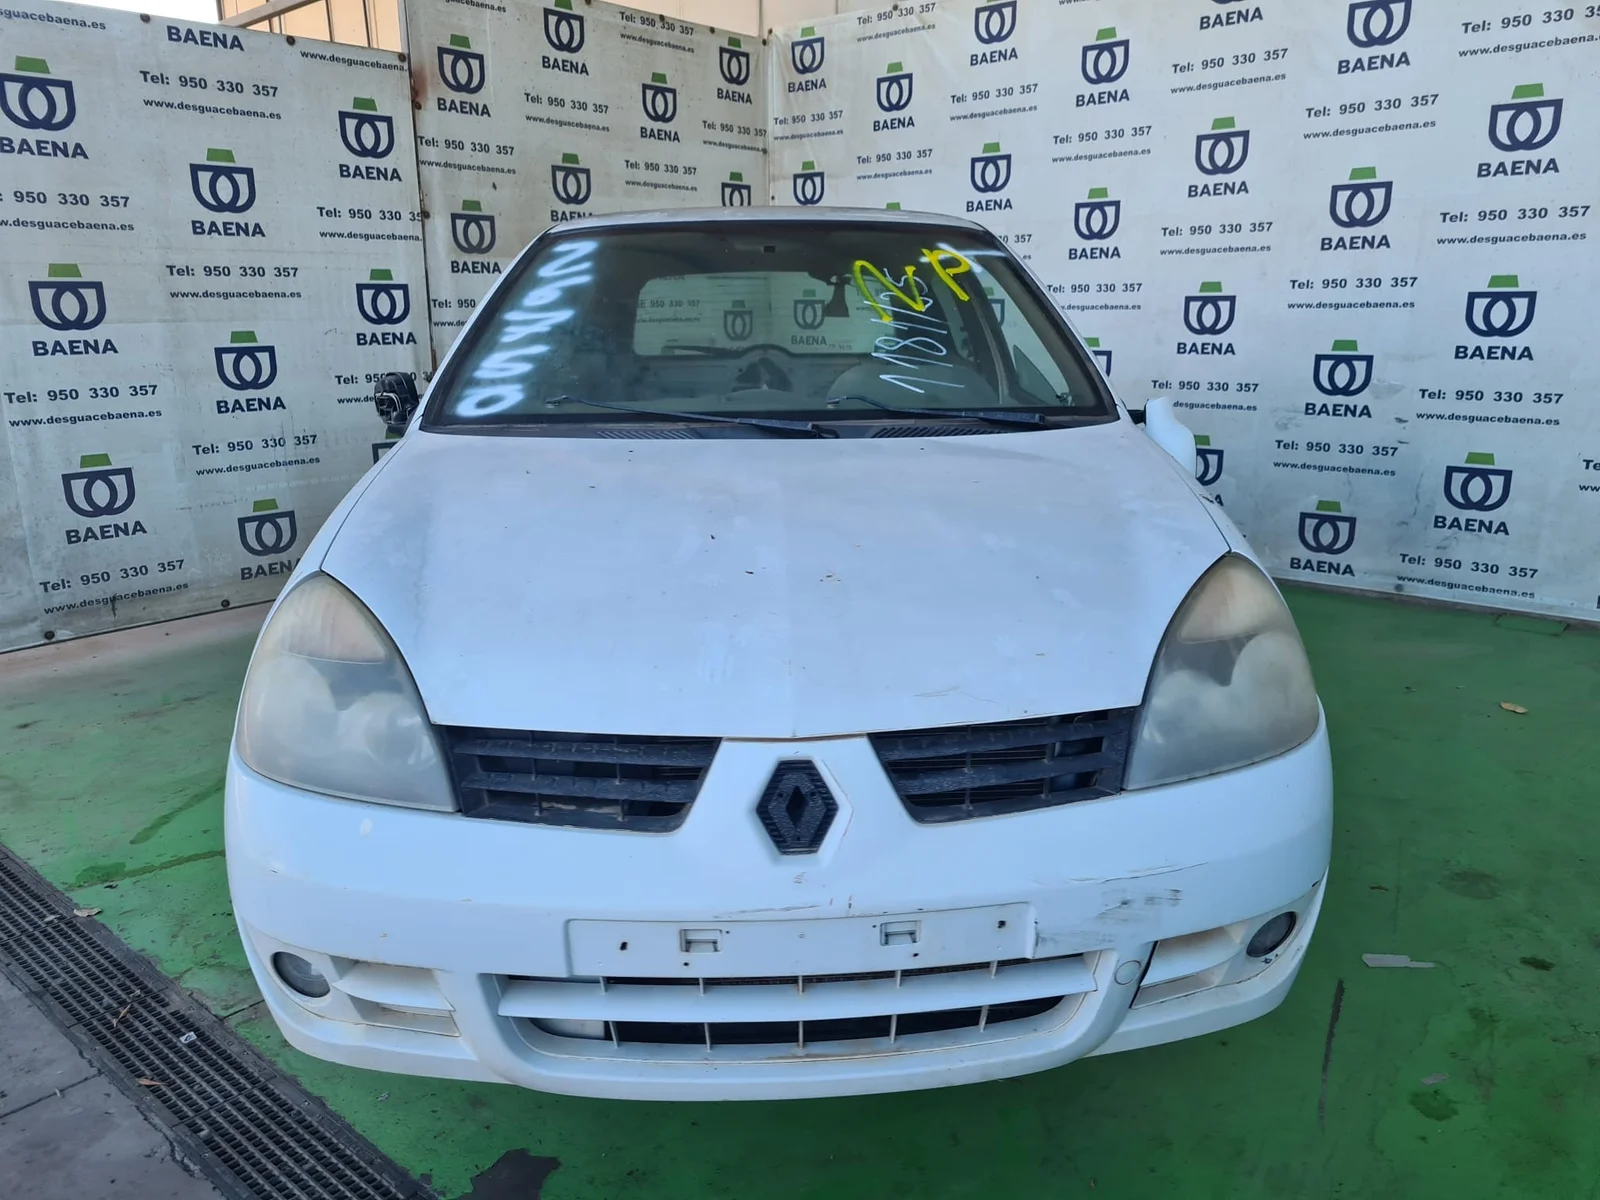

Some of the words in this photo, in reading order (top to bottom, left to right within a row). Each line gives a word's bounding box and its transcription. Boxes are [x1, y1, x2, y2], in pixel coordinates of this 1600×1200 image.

[619, 11, 636, 23] Tel:
[640, 16, 656, 28] 950
[659, 21, 676, 32] 330
[680, 25, 694, 36] 357
[1200, 7, 1263, 30] BAENA
[1462, 20, 1491, 34] Tel:
[1502, 14, 1532, 29] 950
[1542, 8, 1574, 24] 330
[167, 26, 244, 52] BAENA
[970, 48, 1018, 66] BAENA
[1172, 62, 1194, 74] Tel:
[1202, 58, 1224, 70] 950
[1232, 53, 1256, 66] 330
[1264, 48, 1288, 61] 357
[1338, 52, 1410, 74] BAENA
[542, 56, 589, 76] BAENA
[140, 70, 170, 85] Tel:
[179, 76, 208, 90] 950
[217, 80, 244, 94] 330
[252, 84, 278, 97] 357
[788, 78, 826, 93] BAENA
[1171, 74, 1286, 94] www.desguacebaena.es
[717, 88, 752, 105] BAENA
[950, 94, 967, 104] Tel:
[972, 90, 990, 101] 950
[996, 87, 1014, 98] 330
[1020, 84, 1038, 94] 357
[1076, 89, 1130, 107] BAENA
[143, 100, 281, 120] www.desguacebaena.es
[437, 97, 491, 117] BAENA
[524, 93, 542, 104] Tel:
[548, 96, 565, 108] 950
[571, 100, 588, 111] 330
[593, 104, 609, 114] 357
[1306, 106, 1330, 118] Tel:
[1340, 102, 1365, 115] 950
[1374, 98, 1401, 111] 330
[1411, 94, 1439, 107] 357
[874, 116, 915, 132] BAENA
[1304, 121, 1436, 139] www.desguacebaena.es
[640, 127, 680, 143] BAENA
[1053, 134, 1072, 144] Tel:
[1078, 132, 1098, 142] 950
[1105, 129, 1124, 140] 330
[1131, 126, 1152, 137] 357
[0, 137, 89, 160] BAENA
[418, 136, 440, 148] Tel:
[444, 139, 464, 150] 950
[471, 142, 490, 153] 330
[496, 145, 514, 156] 357
[857, 156, 872, 164] Tel:
[876, 153, 892, 162] 950
[896, 151, 912, 160] 330
[917, 149, 932, 158] 357
[1052, 149, 1151, 163] www.desguacebaena.es
[339, 164, 402, 182] BAENA
[419, 159, 516, 175] www.desguacebaena.es
[624, 160, 640, 170] Tel:
[644, 162, 660, 172] 950
[664, 164, 678, 174] 330
[683, 166, 697, 175] 357
[1477, 158, 1559, 178] BAENA
[1188, 181, 1249, 198] BAENA
[14, 191, 47, 204] 950
[58, 193, 90, 206] 330
[100, 195, 130, 208] 357
[966, 198, 1012, 212] BAENA
[317, 207, 341, 218] Tel:
[349, 208, 372, 220] 950
[380, 210, 402, 221] 330
[1440, 212, 1468, 223] Tel:
[1478, 210, 1507, 221] 950
[1518, 208, 1548, 220] 330
[1558, 206, 1590, 218] 357
[192, 220, 266, 237] BAENA
[1162, 227, 1182, 236] Tel:
[1190, 225, 1212, 235] 950
[1220, 224, 1242, 234] 330
[1250, 222, 1273, 232] 357
[1321, 235, 1390, 251] BAENA
[1437, 234, 1586, 244] www.desguacebaena.es
[1069, 246, 1121, 260] BAENA
[1160, 246, 1271, 256] www.desguacebaena.es
[166, 265, 195, 276] Tel:
[204, 266, 230, 277] 950
[240, 266, 266, 277] 330
[274, 267, 298, 277] 357
[451, 260, 502, 274] BAENA
[1047, 285, 1065, 293] Tel:
[1071, 284, 1090, 293] 950
[1096, 284, 1116, 292] 330
[1122, 283, 1142, 292] 357
[1290, 280, 1314, 289] Tel:
[1322, 279, 1347, 289] 950
[1356, 278, 1382, 288] 330
[1391, 277, 1418, 288] 357
[170, 290, 302, 300] www.desguacebaena.es
[1288, 301, 1415, 310] www.desguacebaena.es
[32, 339, 118, 356] BAENA
[356, 332, 417, 346] BAENA
[1177, 342, 1236, 355] BAENA
[1454, 346, 1534, 361] BAENA
[4, 392, 37, 404] Tel:
[48, 389, 79, 401] 950
[89, 387, 119, 398] 330
[129, 385, 157, 396] 357
[1152, 380, 1172, 389] Tel:
[1179, 381, 1200, 390] 950
[1207, 382, 1229, 392] 330
[1236, 383, 1259, 392] 357
[216, 396, 286, 414] BAENA
[1419, 389, 1446, 400] Tel:
[1456, 390, 1484, 401] 950
[1494, 392, 1523, 402] 330
[1533, 393, 1564, 404] 357
[9, 411, 162, 427] www.desguacebaena.es
[1304, 403, 1372, 418] BAENA
[1416, 413, 1560, 426] www.desguacebaena.es
[192, 444, 219, 455] Tel:
[228, 440, 253, 452] 950
[262, 437, 286, 448] 330
[294, 434, 317, 446] 357
[1275, 440, 1298, 450] Tel:
[1306, 442, 1330, 452] 950
[1339, 444, 1364, 454] 330
[1372, 446, 1398, 456] 357
[196, 458, 320, 476] www.desguacebaena.es
[1274, 462, 1396, 476] www.desguacebaena.es
[66, 521, 147, 545] BAENA
[1434, 515, 1509, 536] BAENA
[1290, 557, 1355, 577] BAENA
[1400, 553, 1426, 566] Tel:
[1435, 558, 1462, 570] 950
[1471, 562, 1499, 574] 330
[1508, 566, 1538, 578] 357
[39, 579, 71, 593] Tel:
[80, 572, 110, 586] 950
[120, 565, 148, 579] 330
[158, 559, 184, 572] 357
[1396, 575, 1534, 598] www.desguacebaena.es
[44, 584, 188, 614] www.desguacebaena.es
